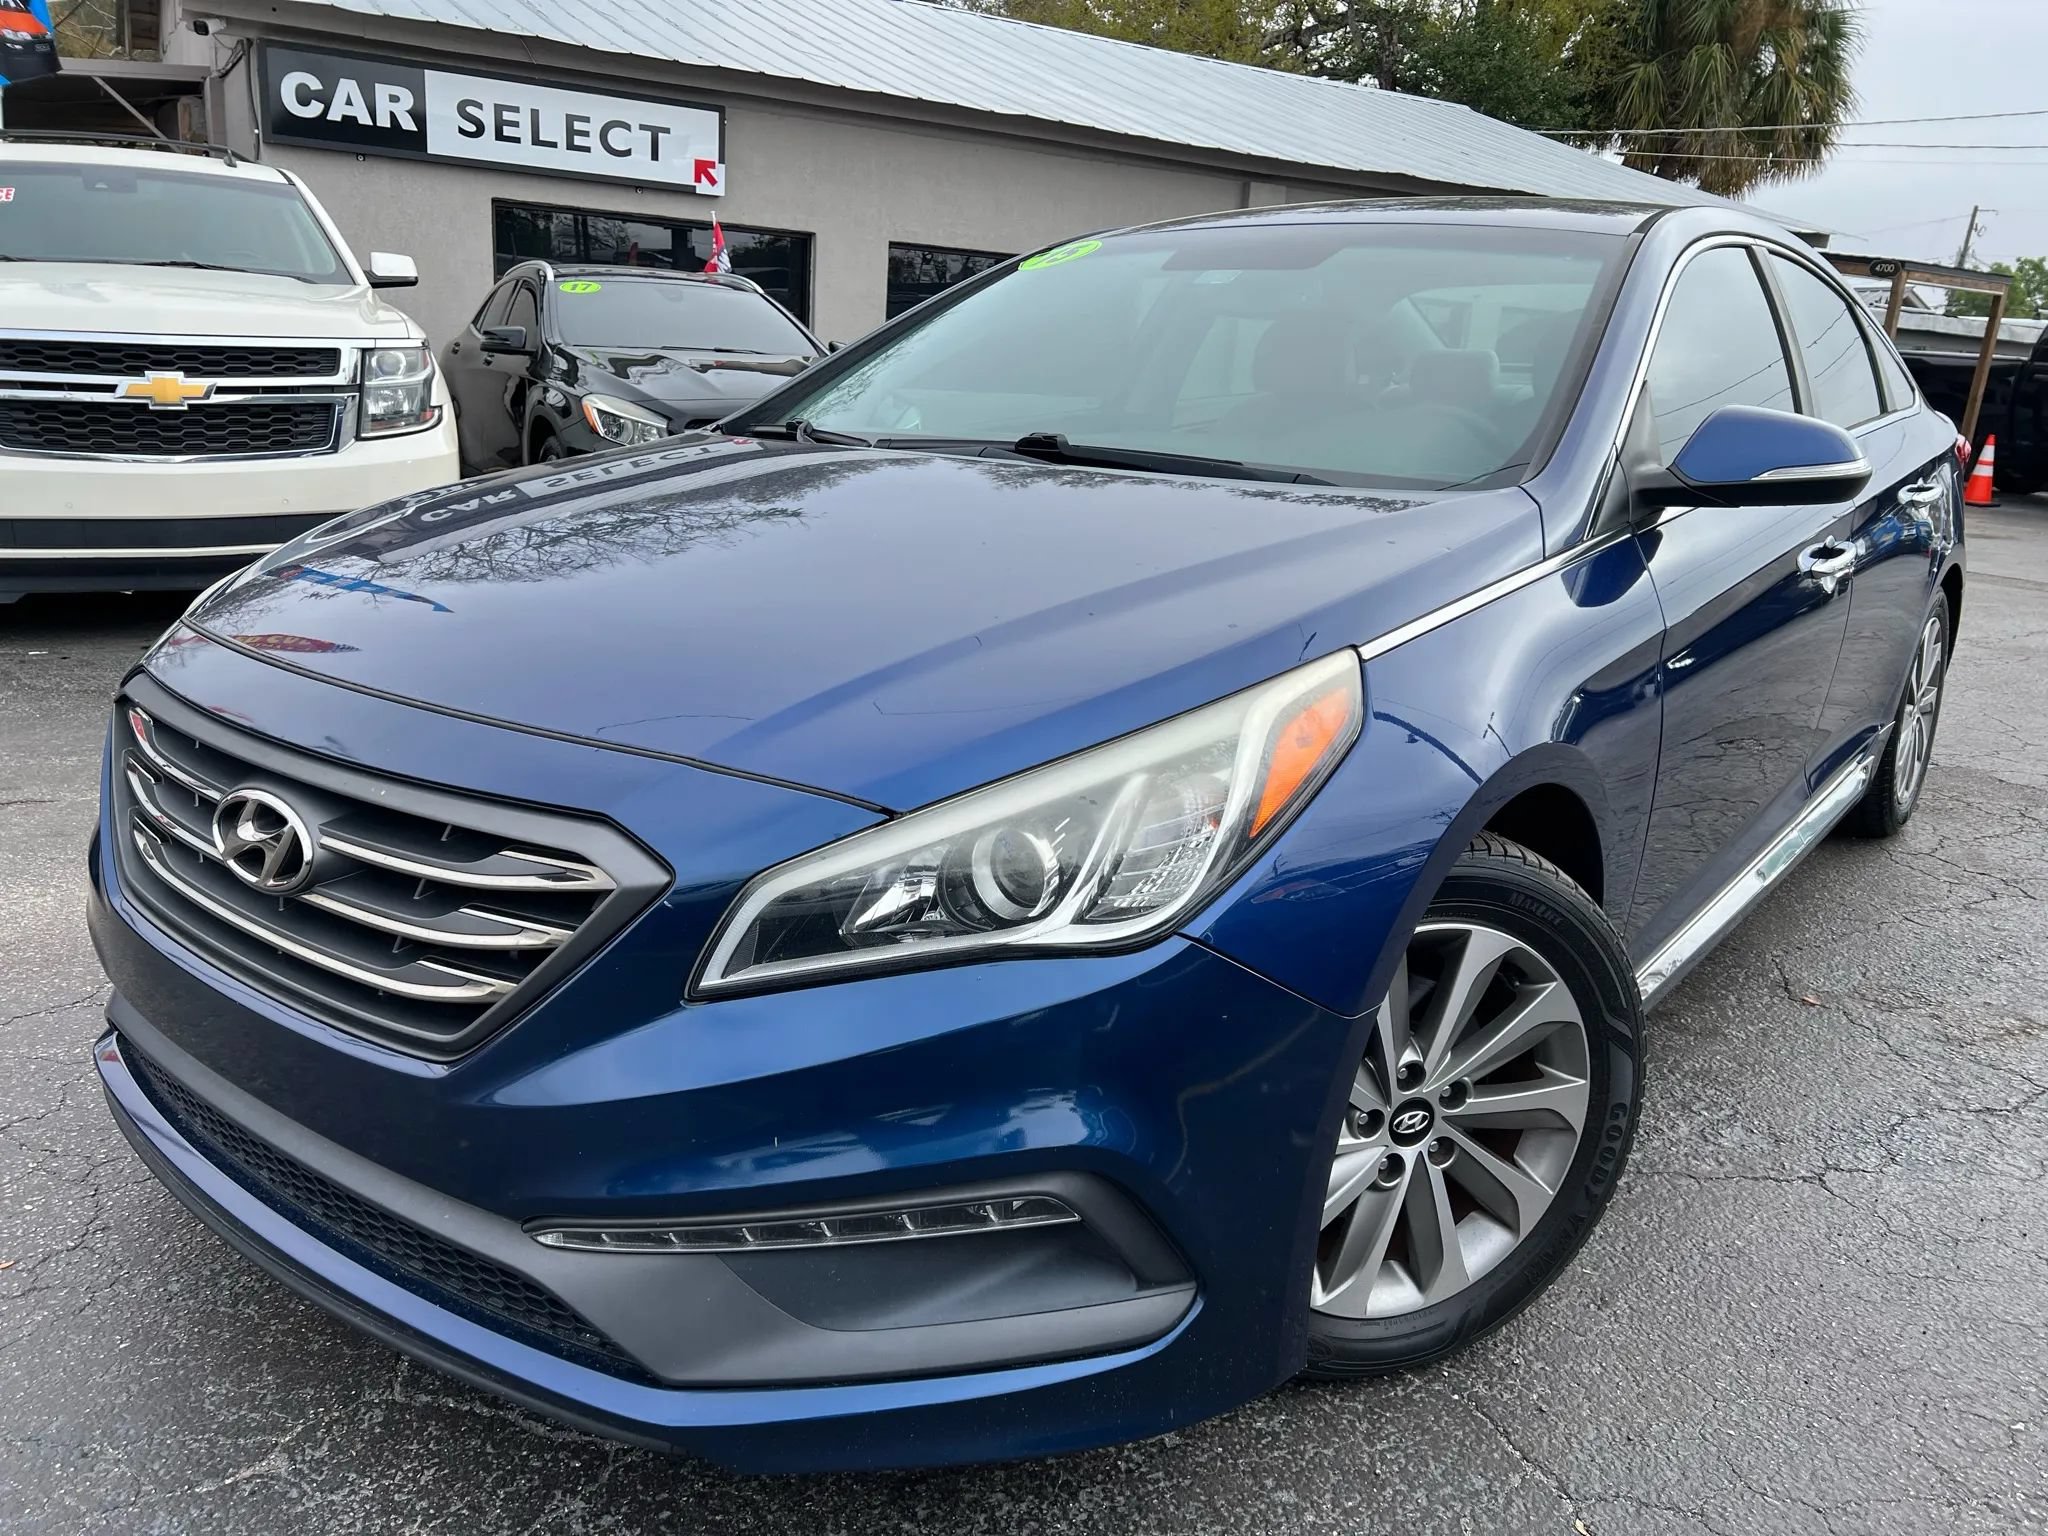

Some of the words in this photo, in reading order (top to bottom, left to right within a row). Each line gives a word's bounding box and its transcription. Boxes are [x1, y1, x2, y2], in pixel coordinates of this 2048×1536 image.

[280, 71, 419, 132] CAR
[456, 98, 671, 162] SELECT
[1875, 263, 1895, 273] 4700
[570, 283, 592, 291] 17
